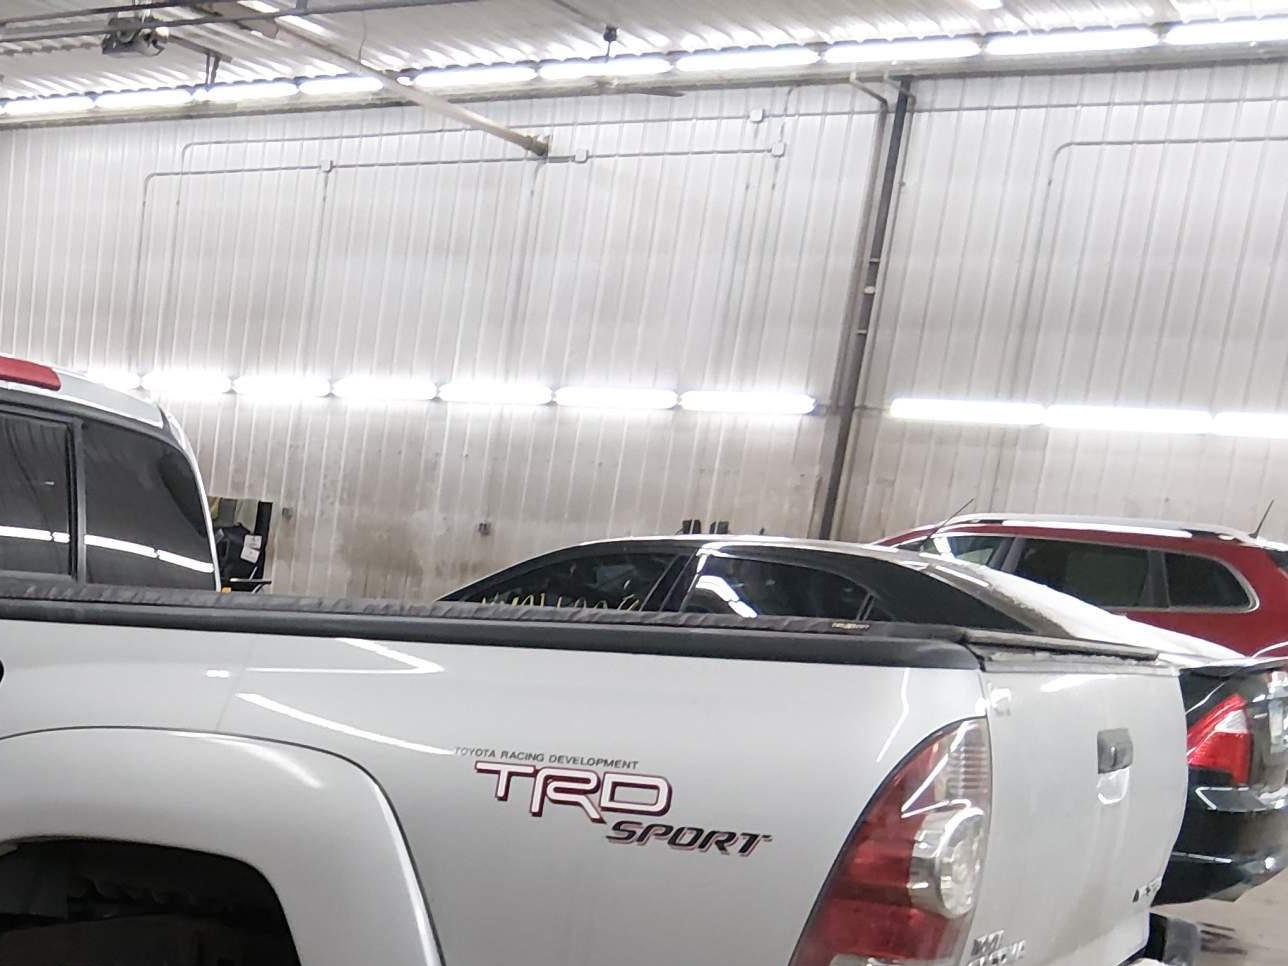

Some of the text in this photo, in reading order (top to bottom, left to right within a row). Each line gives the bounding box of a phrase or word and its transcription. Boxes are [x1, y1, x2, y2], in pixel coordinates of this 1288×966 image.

[455, 745, 640, 771] TOYOTA RACING DEVELOPMENT
[473, 760, 673, 824] TRD
[605, 819, 771, 857] SPORT
